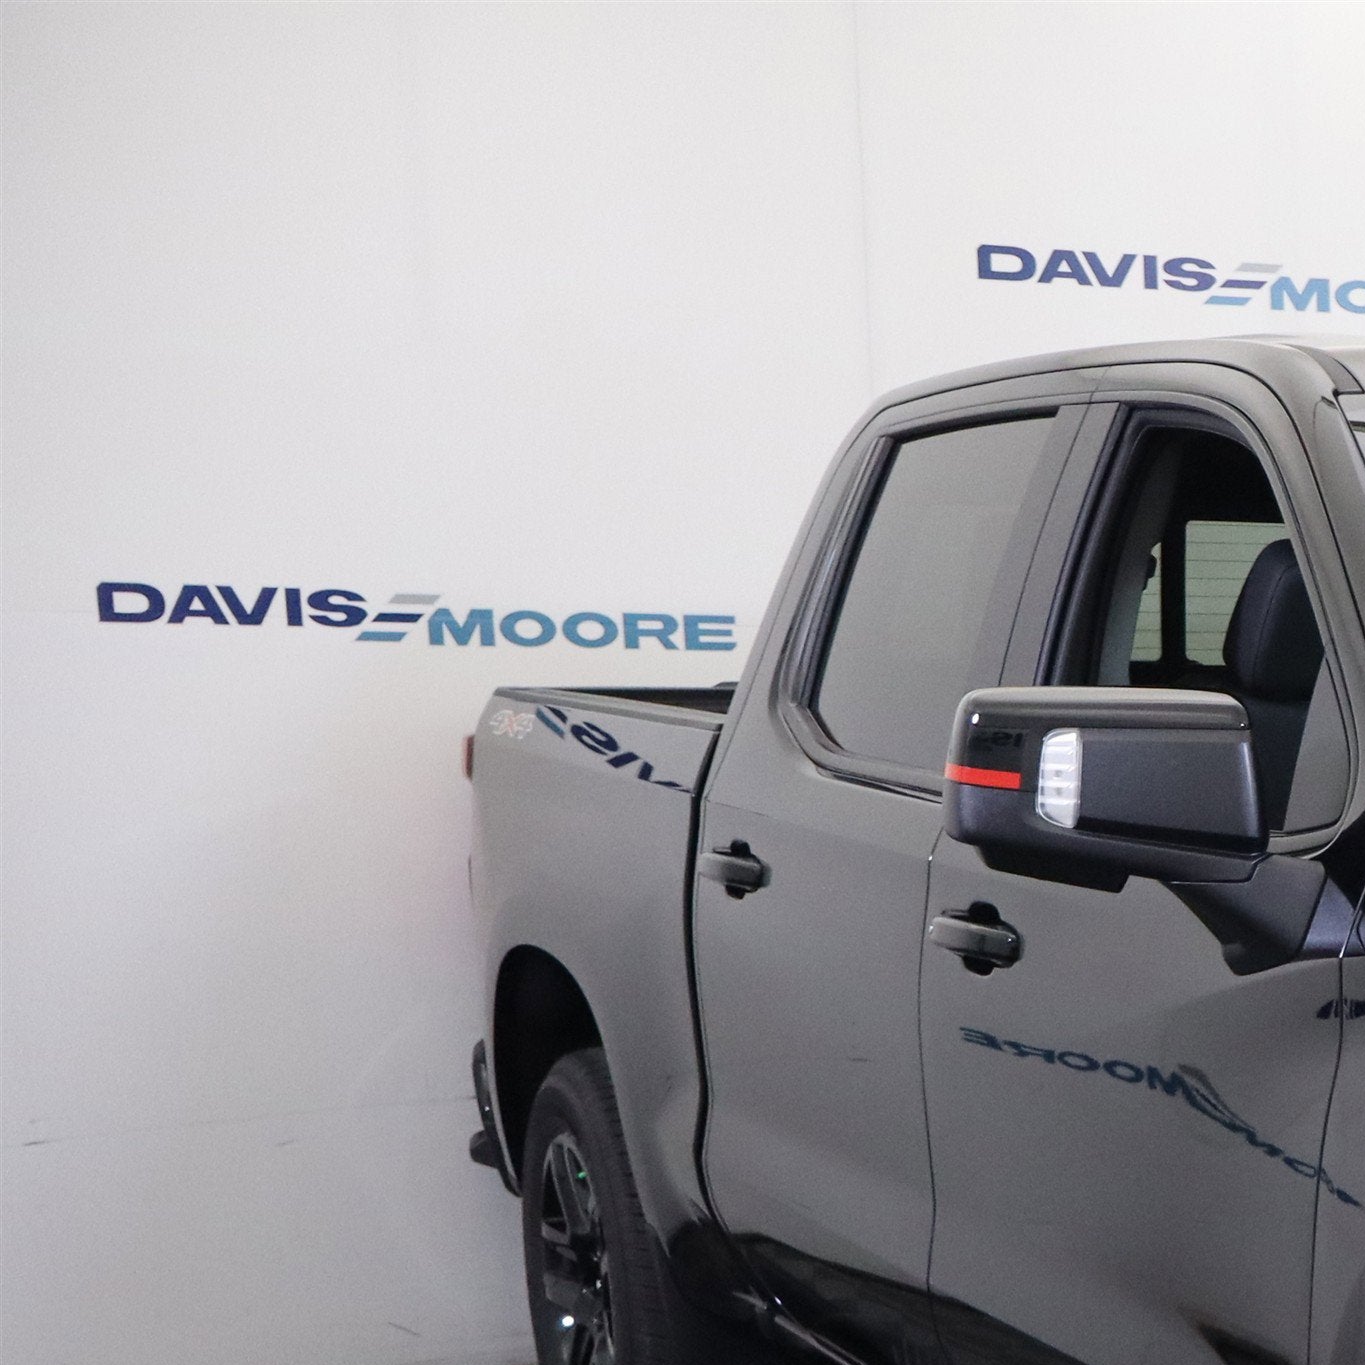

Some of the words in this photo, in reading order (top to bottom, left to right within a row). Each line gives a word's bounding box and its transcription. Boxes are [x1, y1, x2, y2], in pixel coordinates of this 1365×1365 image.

[976, 243, 1217, 293] DAVIS
[95, 580, 369, 628] DAVIS
[427, 607, 738, 652] MOORE
